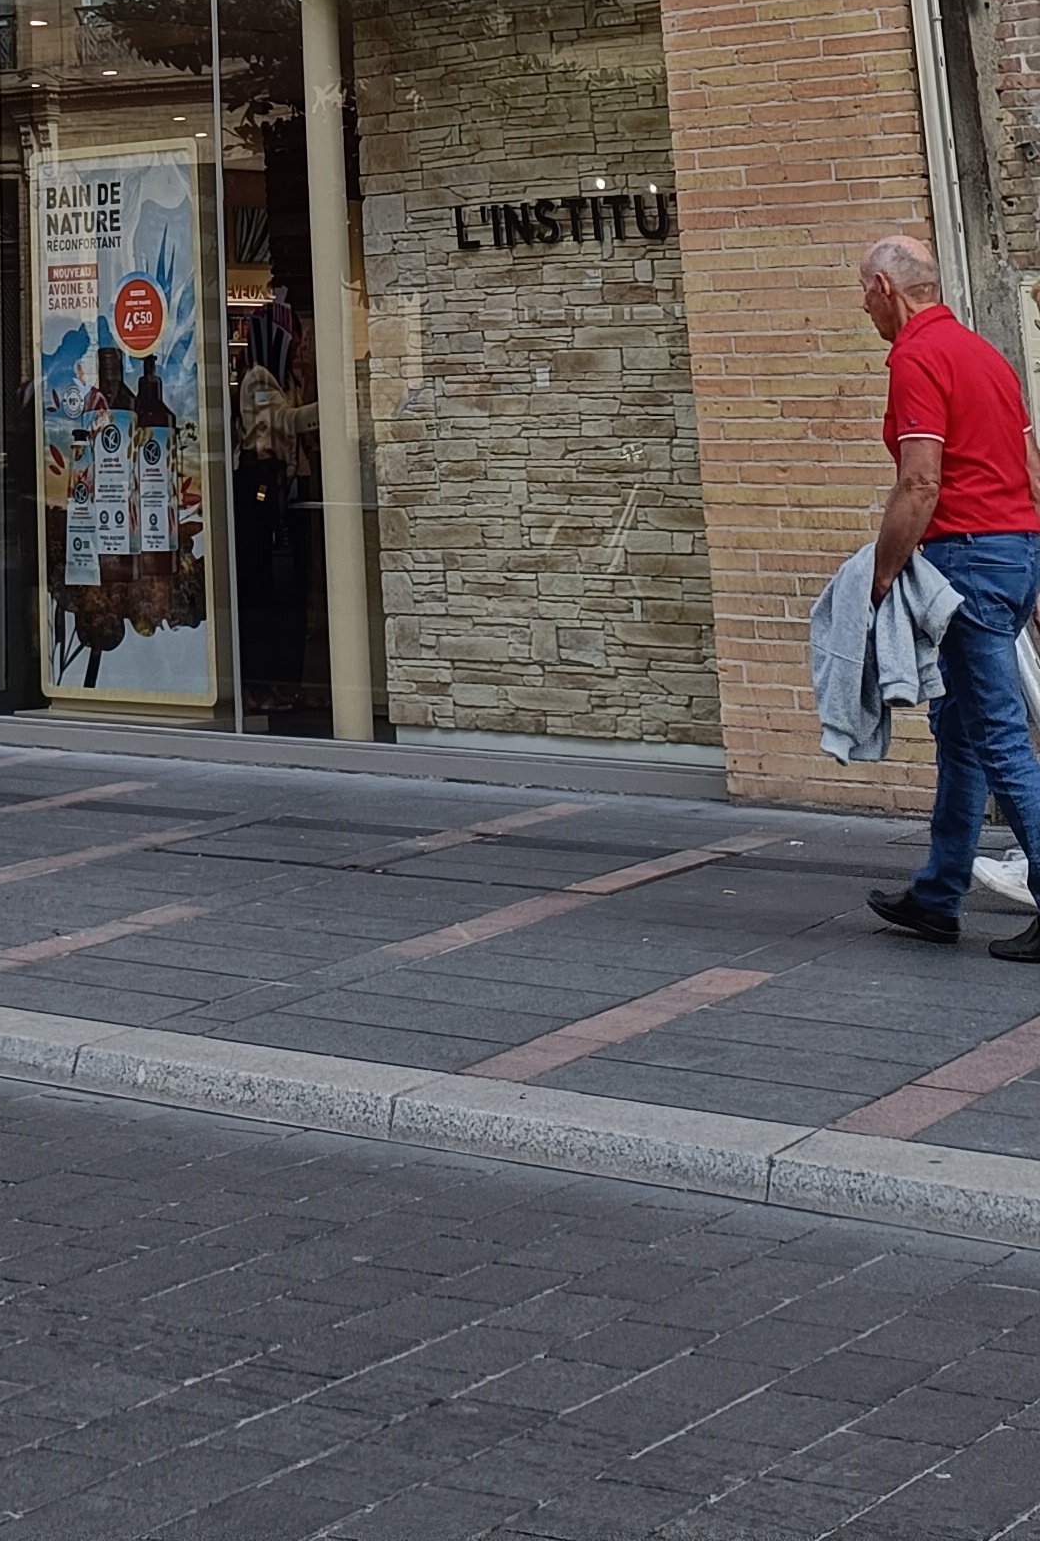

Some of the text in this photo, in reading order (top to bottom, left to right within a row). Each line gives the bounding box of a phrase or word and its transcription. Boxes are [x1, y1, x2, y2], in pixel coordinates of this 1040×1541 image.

[46, 182, 121, 209] BAIN DE
[46, 209, 121, 236] NATURE
[46, 236, 122, 252] RÉCONFORTANT
[48, 282, 94, 296] AVOINE &
[48, 296, 100, 310] SARRASIN
